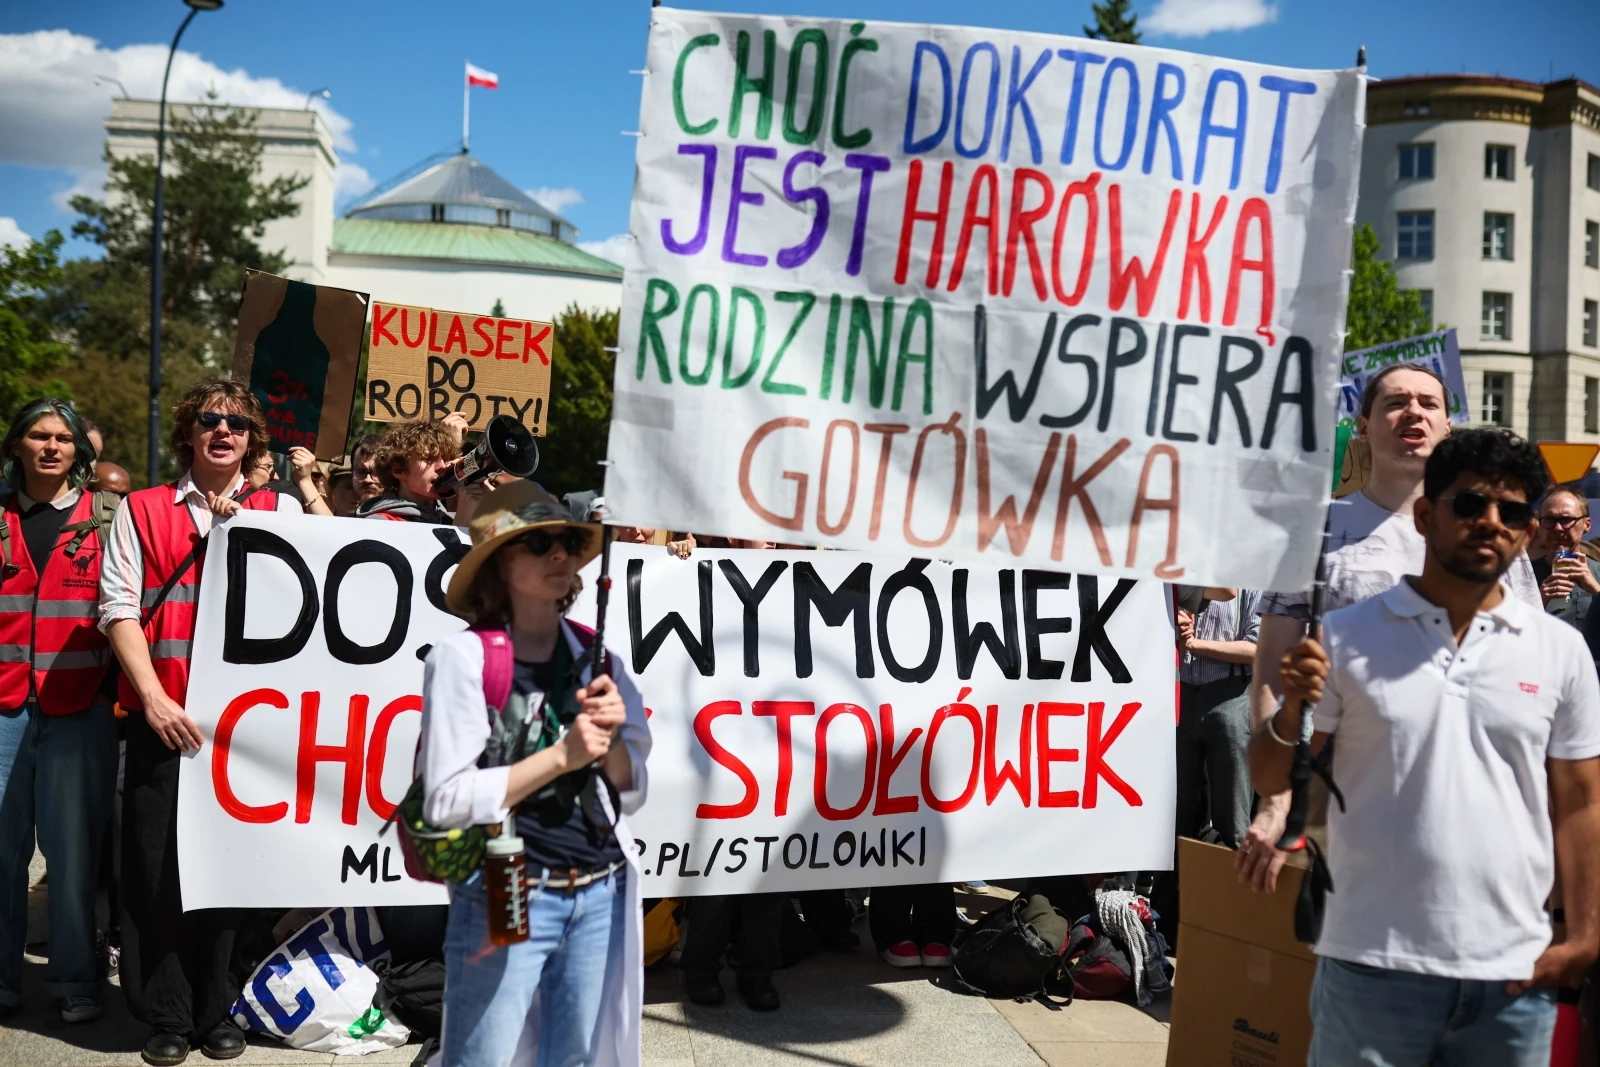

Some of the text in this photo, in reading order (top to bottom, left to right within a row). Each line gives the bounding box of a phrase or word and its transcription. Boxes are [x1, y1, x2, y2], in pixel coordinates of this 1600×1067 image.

[672, 22, 1316, 194] CHOĆ DOKTORAT
[660, 143, 1275, 347] JEST HARÓWKĄ
[371, 304, 552, 366] KULASEK
[427, 355, 476, 393] DO
[637, 278, 1317, 452] RODZINA WSPIERA
[265, 407, 296, 427] NA
[267, 370, 309, 404] 3%
[369, 379, 543, 434] ROBOTY!
[738, 411, 1185, 578] GOTÓWKĄ
[626, 558, 1138, 684] WYMÓWEK
[693, 686, 1143, 820] STOŁÓWEK
[633, 827, 926, 878] .PL/STOLOWKI
